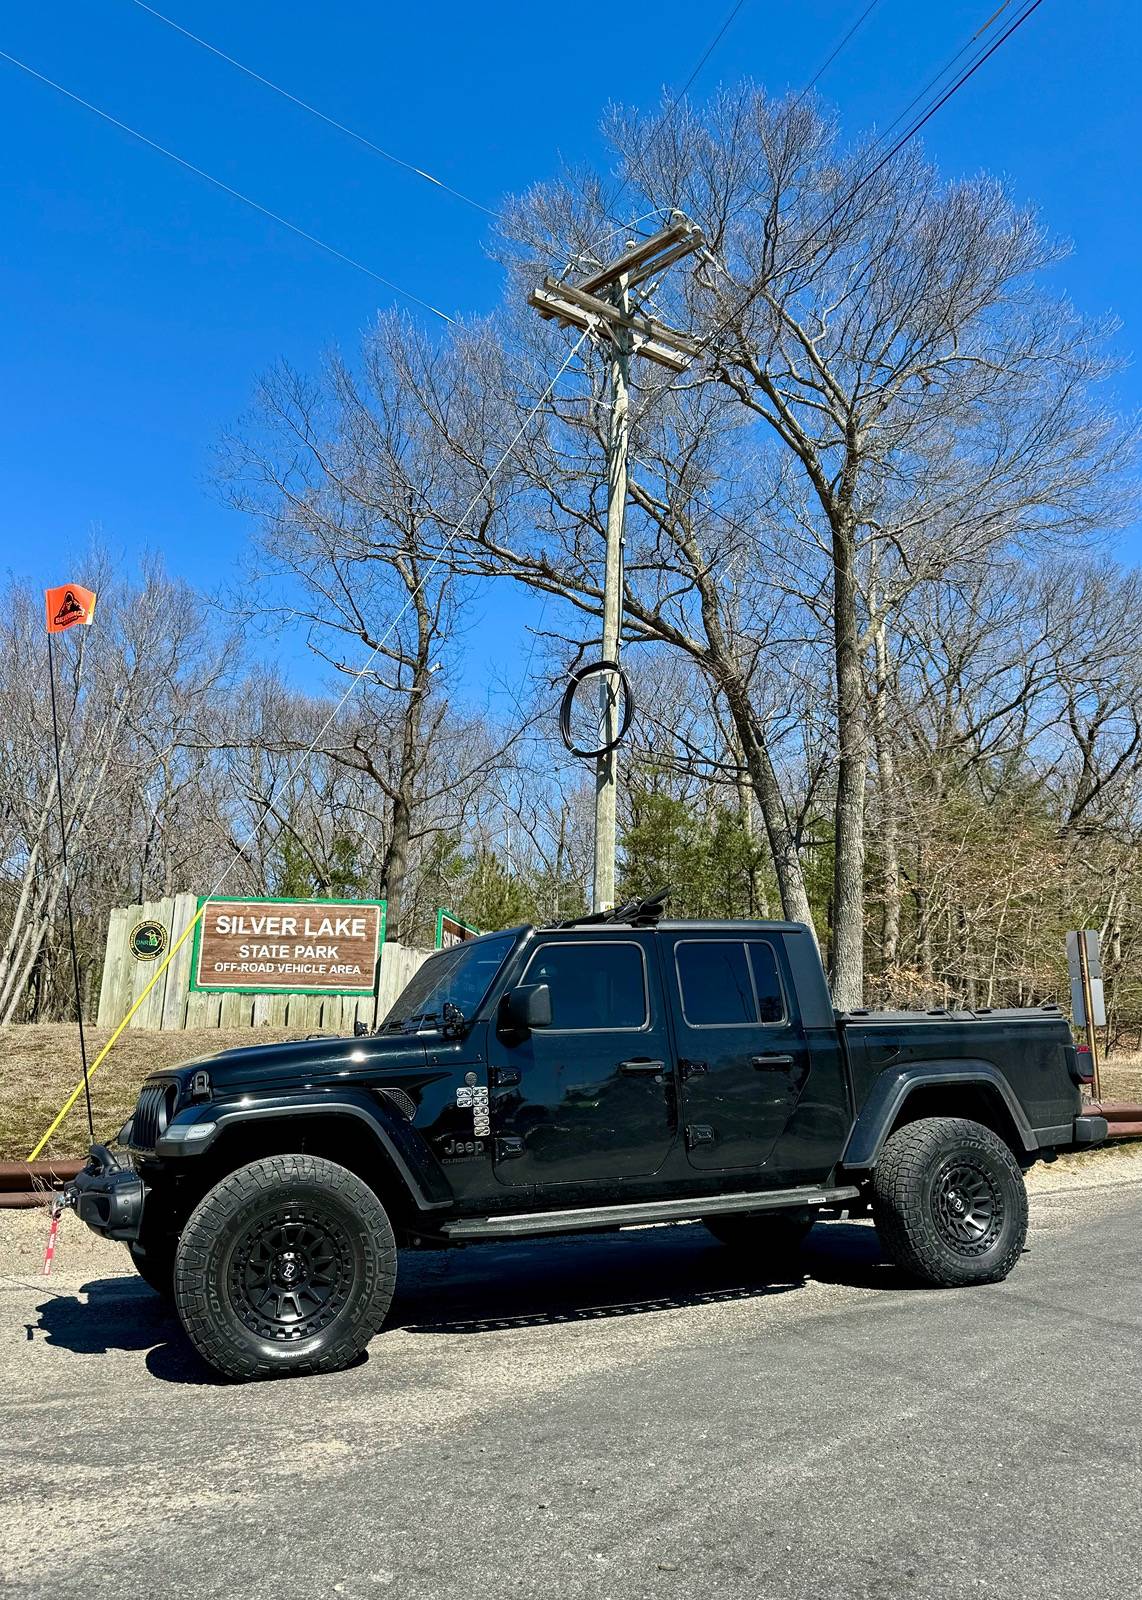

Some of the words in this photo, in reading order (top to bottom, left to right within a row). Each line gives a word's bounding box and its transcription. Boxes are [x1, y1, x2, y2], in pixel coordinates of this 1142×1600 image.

[215, 915, 298, 936] SILVER
[304, 917, 366, 937] LAKE
[239, 945, 290, 959] STATE
[294, 945, 339, 959] PARK
[214, 962, 275, 974] OFF-ROAD
[278, 963, 327, 974] VEHICLE
[329, 964, 361, 975] AREA
[444, 1139, 484, 1156] Jeep
